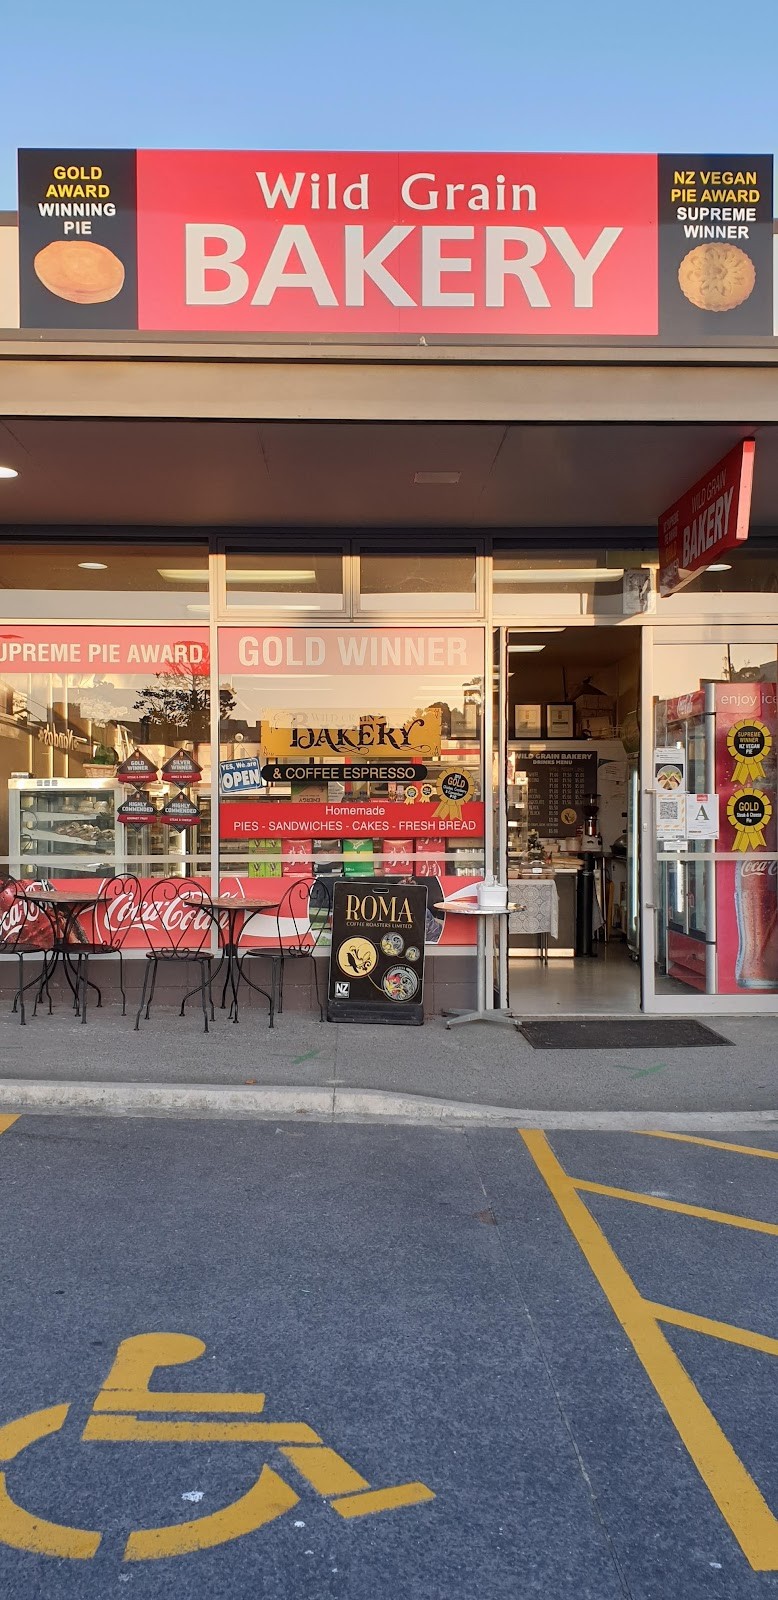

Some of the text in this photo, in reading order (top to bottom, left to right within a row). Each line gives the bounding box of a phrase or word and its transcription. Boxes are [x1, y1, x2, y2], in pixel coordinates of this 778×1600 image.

[53, 166, 103, 180] GOLD
[673, 171, 757, 186] NZ VEGAN
[45, 184, 110, 198] AWARD
[255, 171, 538, 211] Wild Grain
[671, 189, 760, 203] PIE AWARD
[38, 203, 116, 217] WINNING
[676, 207, 757, 221] SUPREME
[63, 221, 92, 235] PIE
[683, 224, 750, 239] WINNER
[184, 222, 624, 308] BAKERY
[682, 486, 735, 569] BAKERY
[88, 644, 120, 663] PIE
[127, 644, 204, 664] AWARD
[238, 635, 469, 667] GOLD WINNER
[720, 694, 757, 707] enjoy
[236, 761, 246, 769] We
[222, 769, 260, 788] OPEN
[272, 767, 416, 779] & COFFEE ESPRESSO
[447, 776, 466, 788] GOLD
[324, 805, 386, 816] Homemade
[695, 804, 710, 820] A
[738, 802, 760, 811] GOLD
[233, 821, 259, 831] PIES
[268, 821, 343, 831] SANDWICHES
[352, 821, 390, 831] CAKES
[398, 821, 436, 831] FRESH
[438, 821, 477, 831] BREAD
[345, 894, 413, 923] ROMA
[336, 983, 349, 993] NZ
